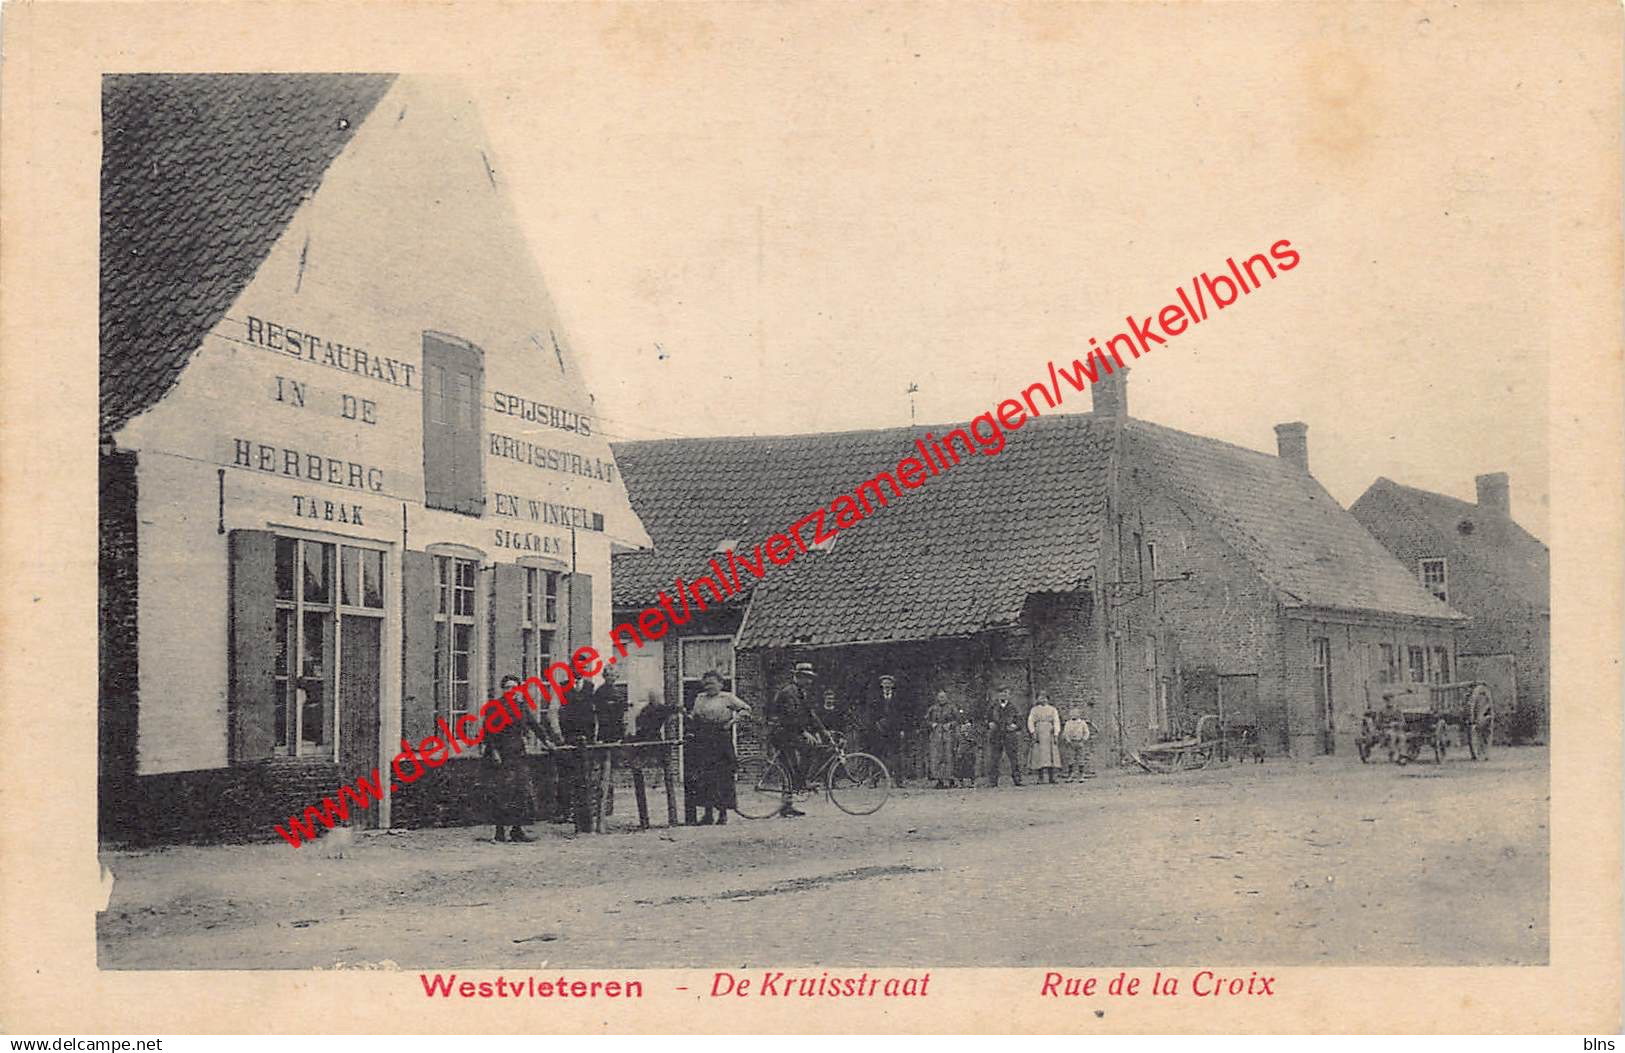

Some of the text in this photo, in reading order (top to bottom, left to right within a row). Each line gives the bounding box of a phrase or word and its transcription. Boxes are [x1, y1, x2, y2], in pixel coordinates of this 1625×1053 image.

[247, 315, 592, 437] RESTAURANT SPIJSHUIS
[275, 376, 615, 483] IN DE KRUISSTRAAT
[233, 438, 594, 531] HERBERG EN WINKEL
[292, 495, 561, 554] TABAK SIGAREN
